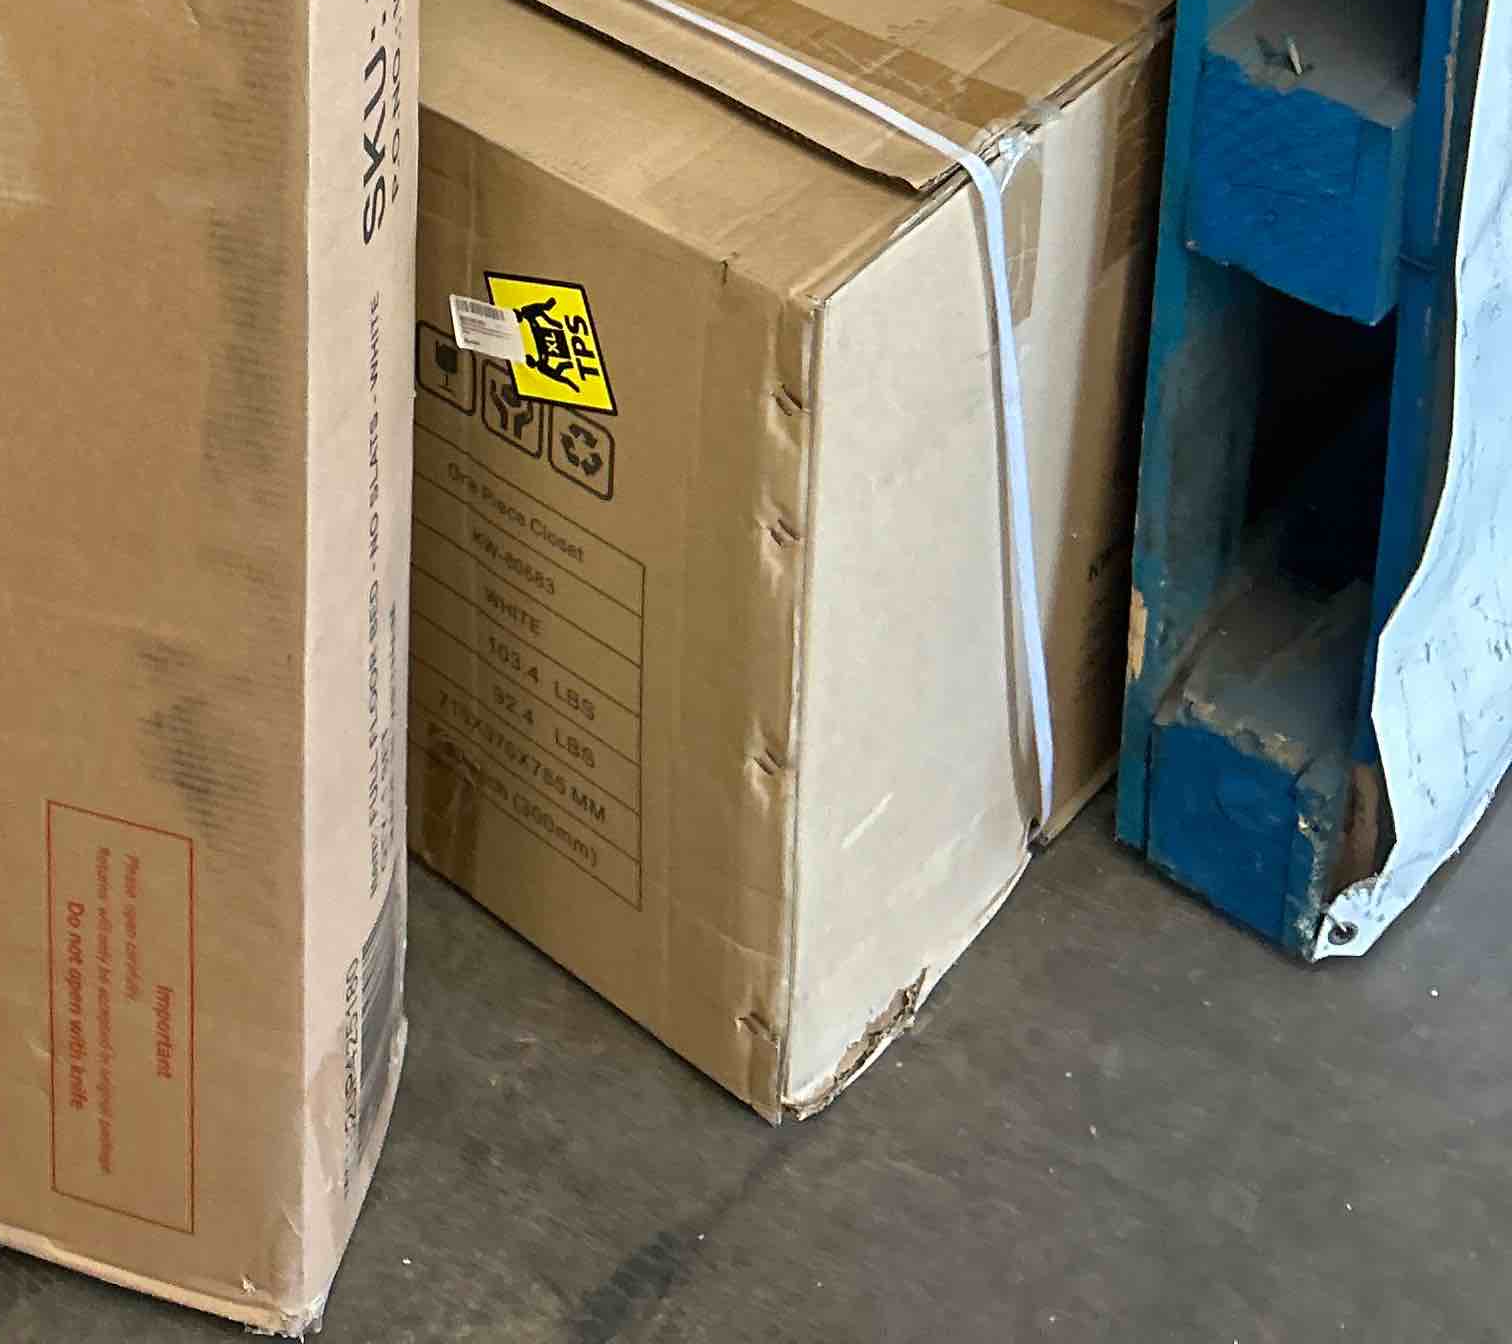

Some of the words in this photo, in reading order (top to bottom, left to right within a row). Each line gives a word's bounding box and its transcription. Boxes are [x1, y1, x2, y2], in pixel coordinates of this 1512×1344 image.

[362, 9, 387, 245] SKU:
[544, 333, 561, 355] XL
[564, 314, 601, 382] TPS
[529, 516, 585, 564] Closet
[484, 586, 545, 635] WHITE
[554, 679, 595, 721] LBS
[553, 727, 596, 769] LBS
[570, 785, 607, 824] MM
[66, 900, 86, 929] Do
[68, 932, 88, 965] not
[67, 968, 87, 1014] open
[69, 1019, 89, 1060] with
[155, 985, 175, 1079] Important
[70, 1063, 90, 1111] knife
